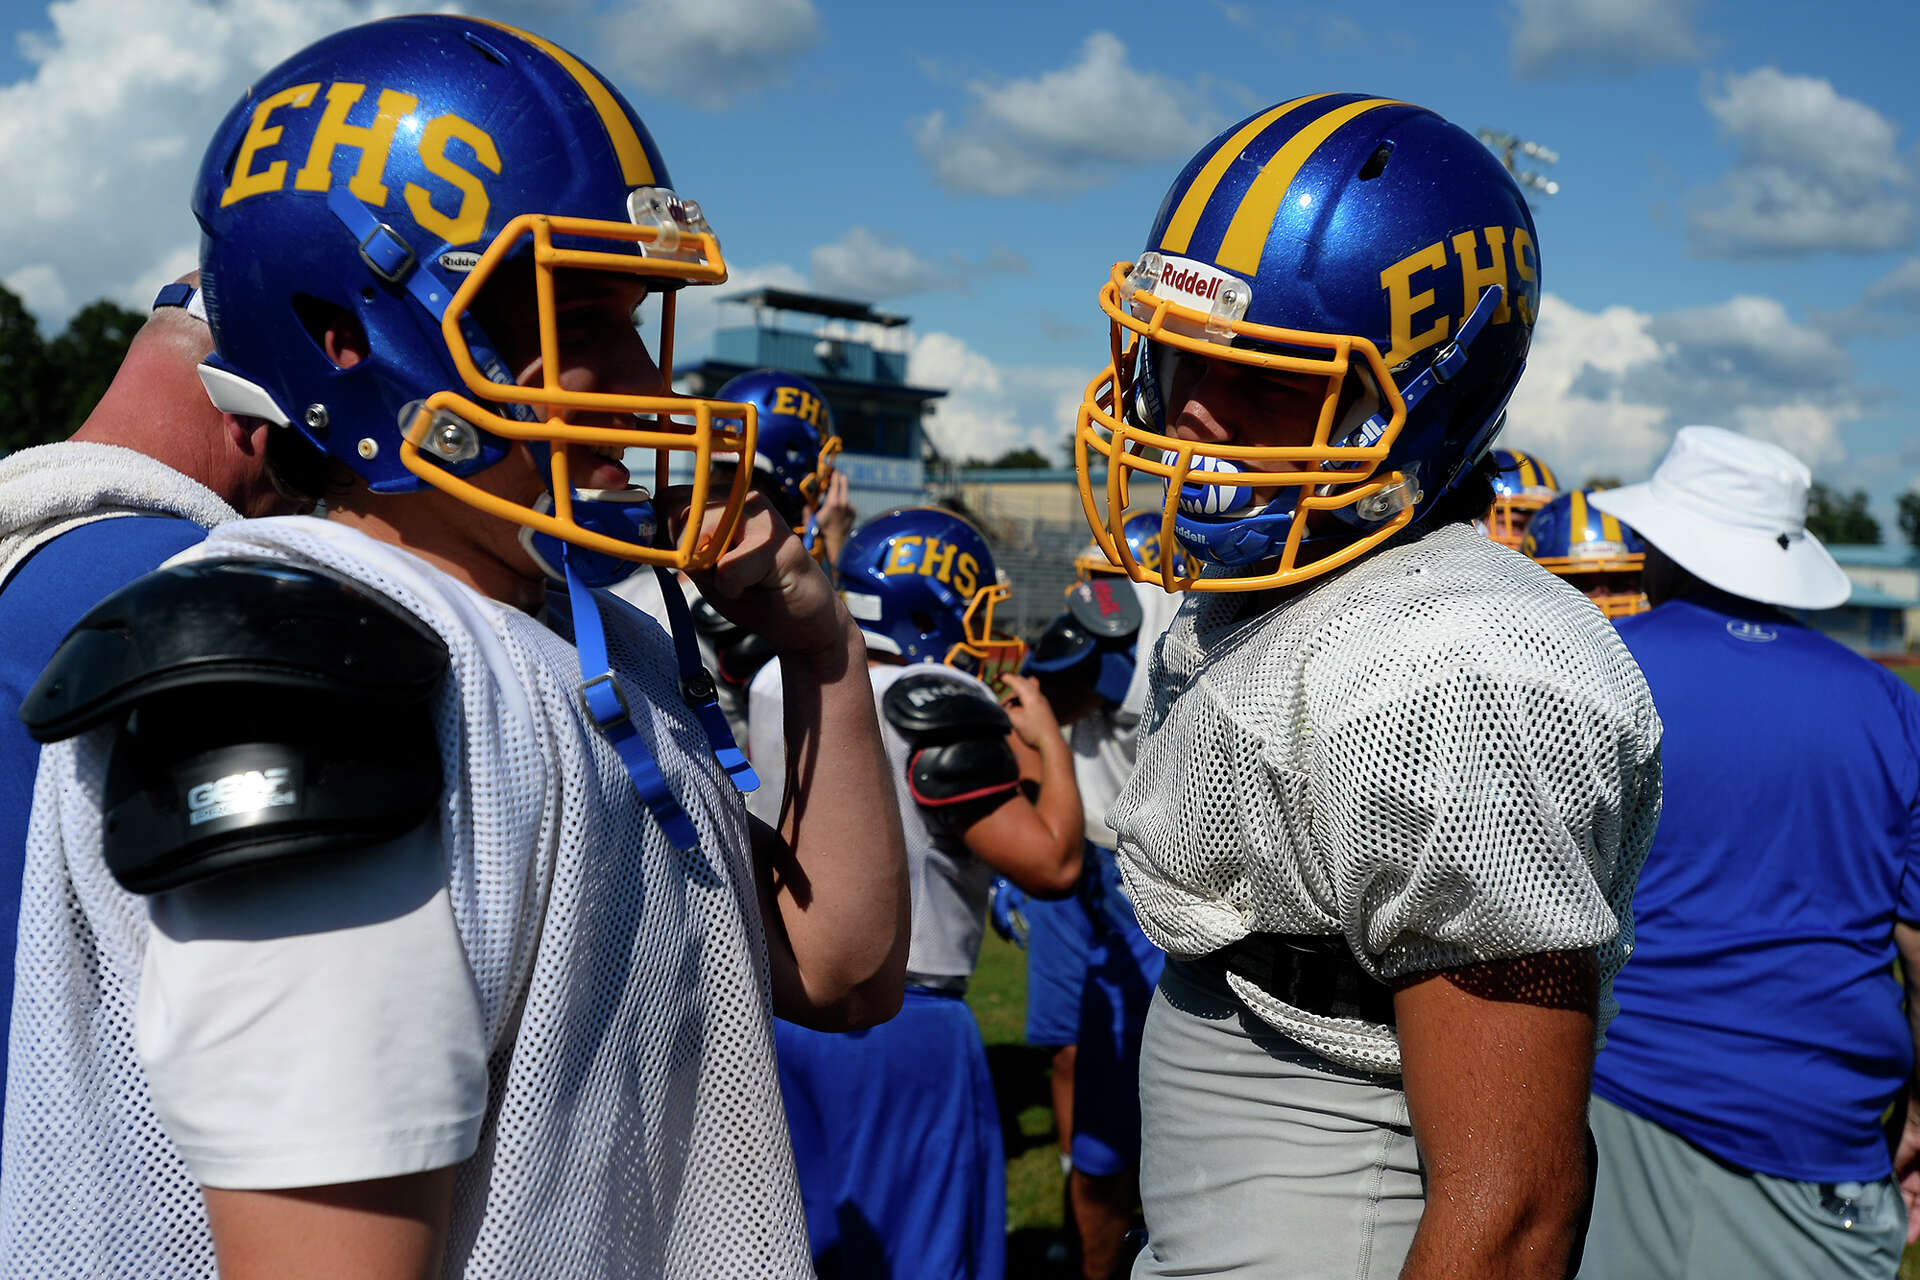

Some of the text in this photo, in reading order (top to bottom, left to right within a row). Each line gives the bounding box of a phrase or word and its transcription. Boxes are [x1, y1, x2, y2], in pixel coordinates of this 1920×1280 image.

[220, 82, 502, 246] EHS
[442, 255, 480, 267] Ridde
[1161, 262, 1224, 300] Riddell
[1380, 226, 1537, 369] EHS
[884, 535, 979, 600] EHS
